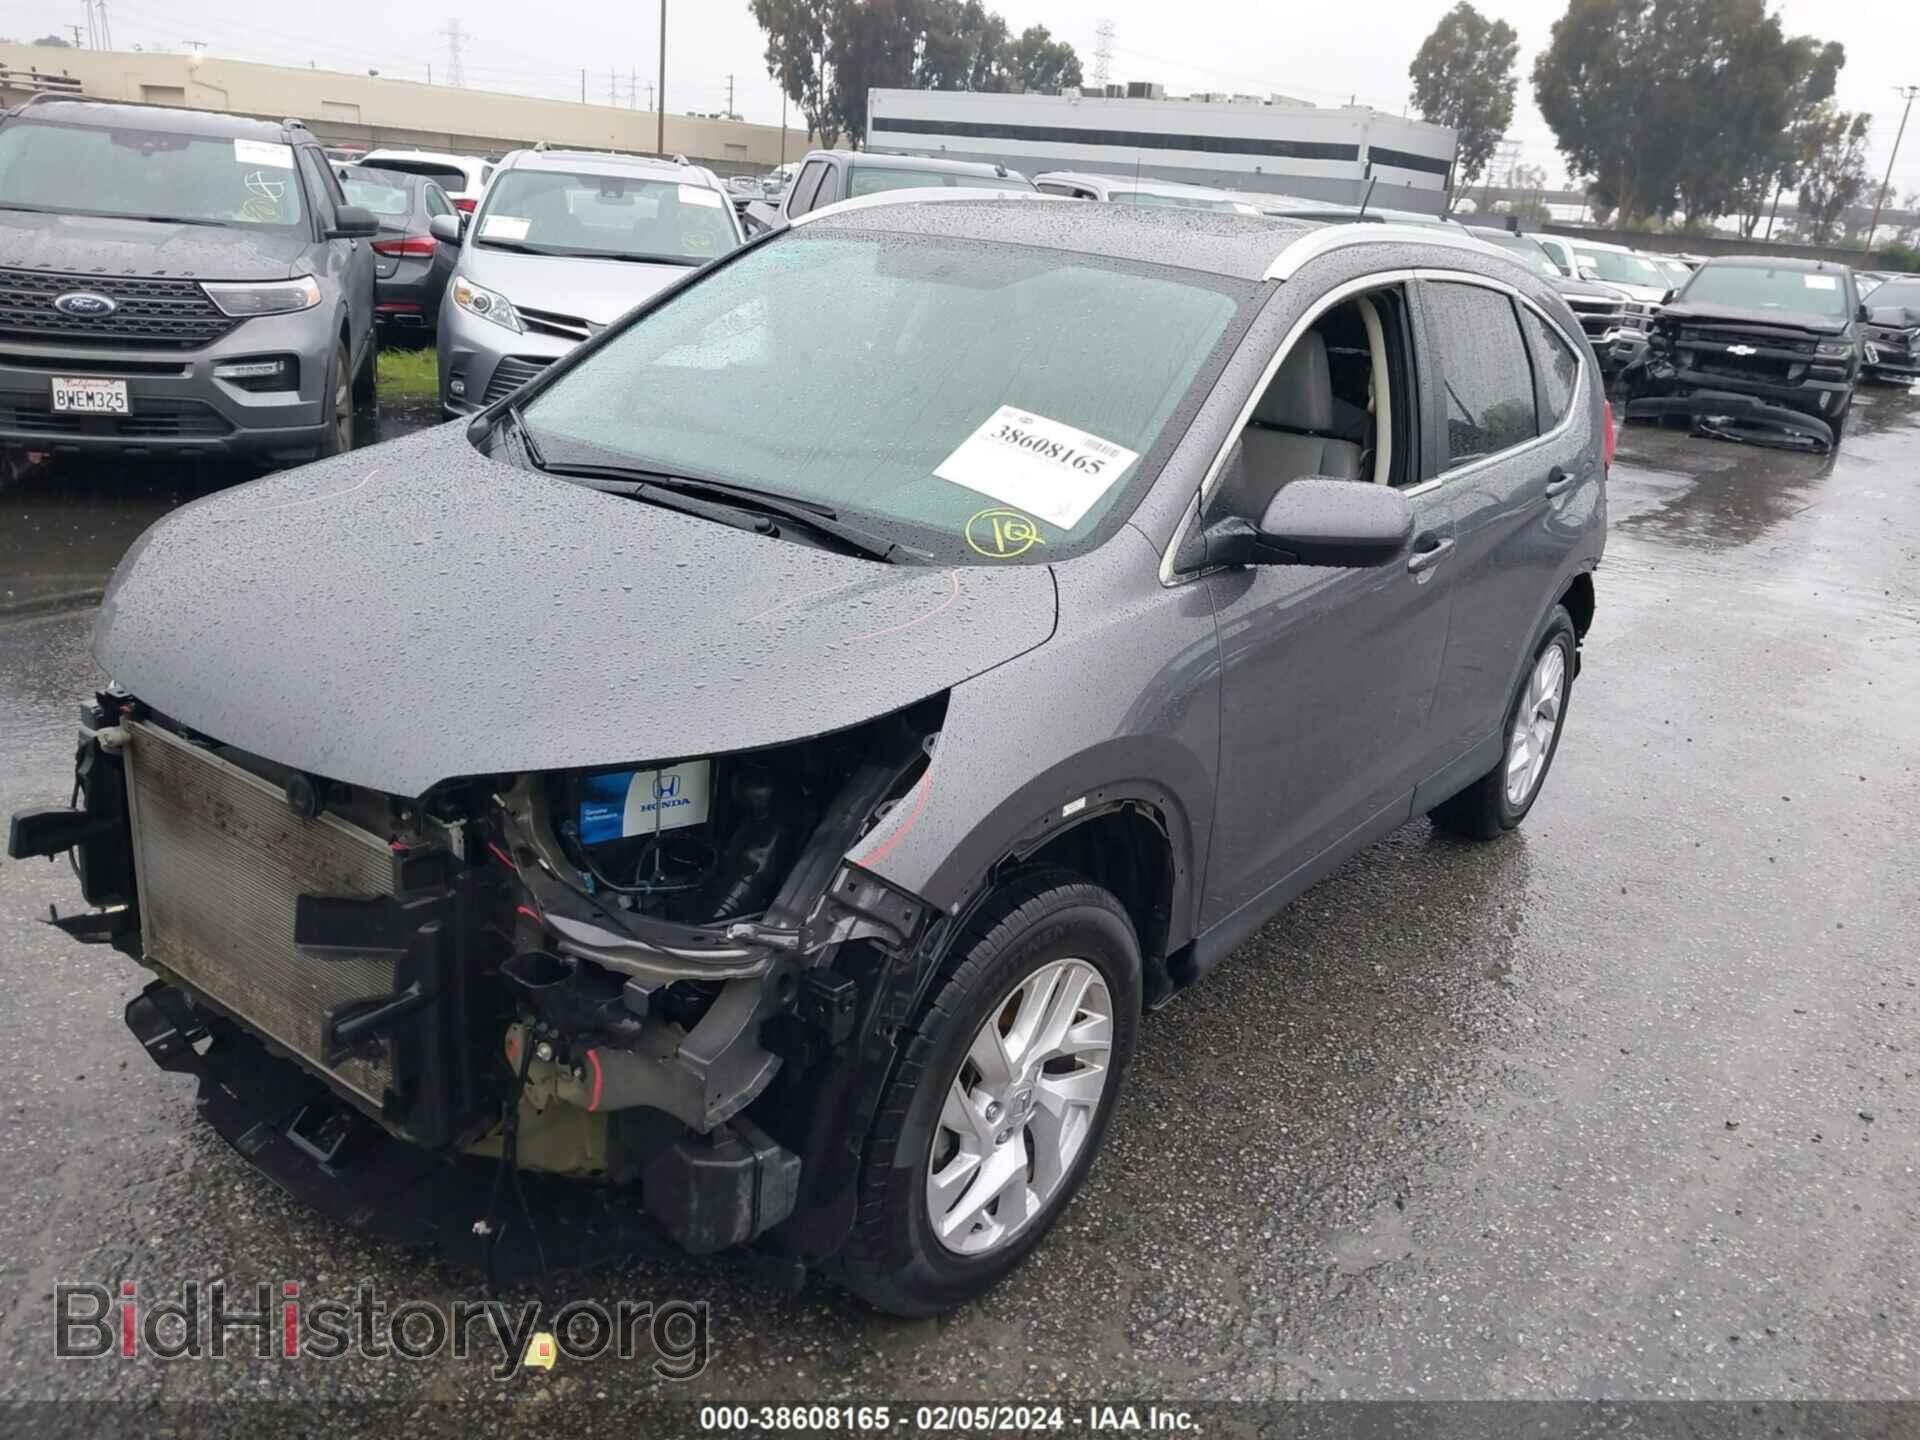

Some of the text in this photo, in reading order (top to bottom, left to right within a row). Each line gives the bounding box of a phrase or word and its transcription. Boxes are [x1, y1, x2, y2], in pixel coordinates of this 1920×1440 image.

[69, 298, 101, 311] Ford
[56, 390, 125, 409] 8WEM325
[990, 424, 1106, 474] 38608165
